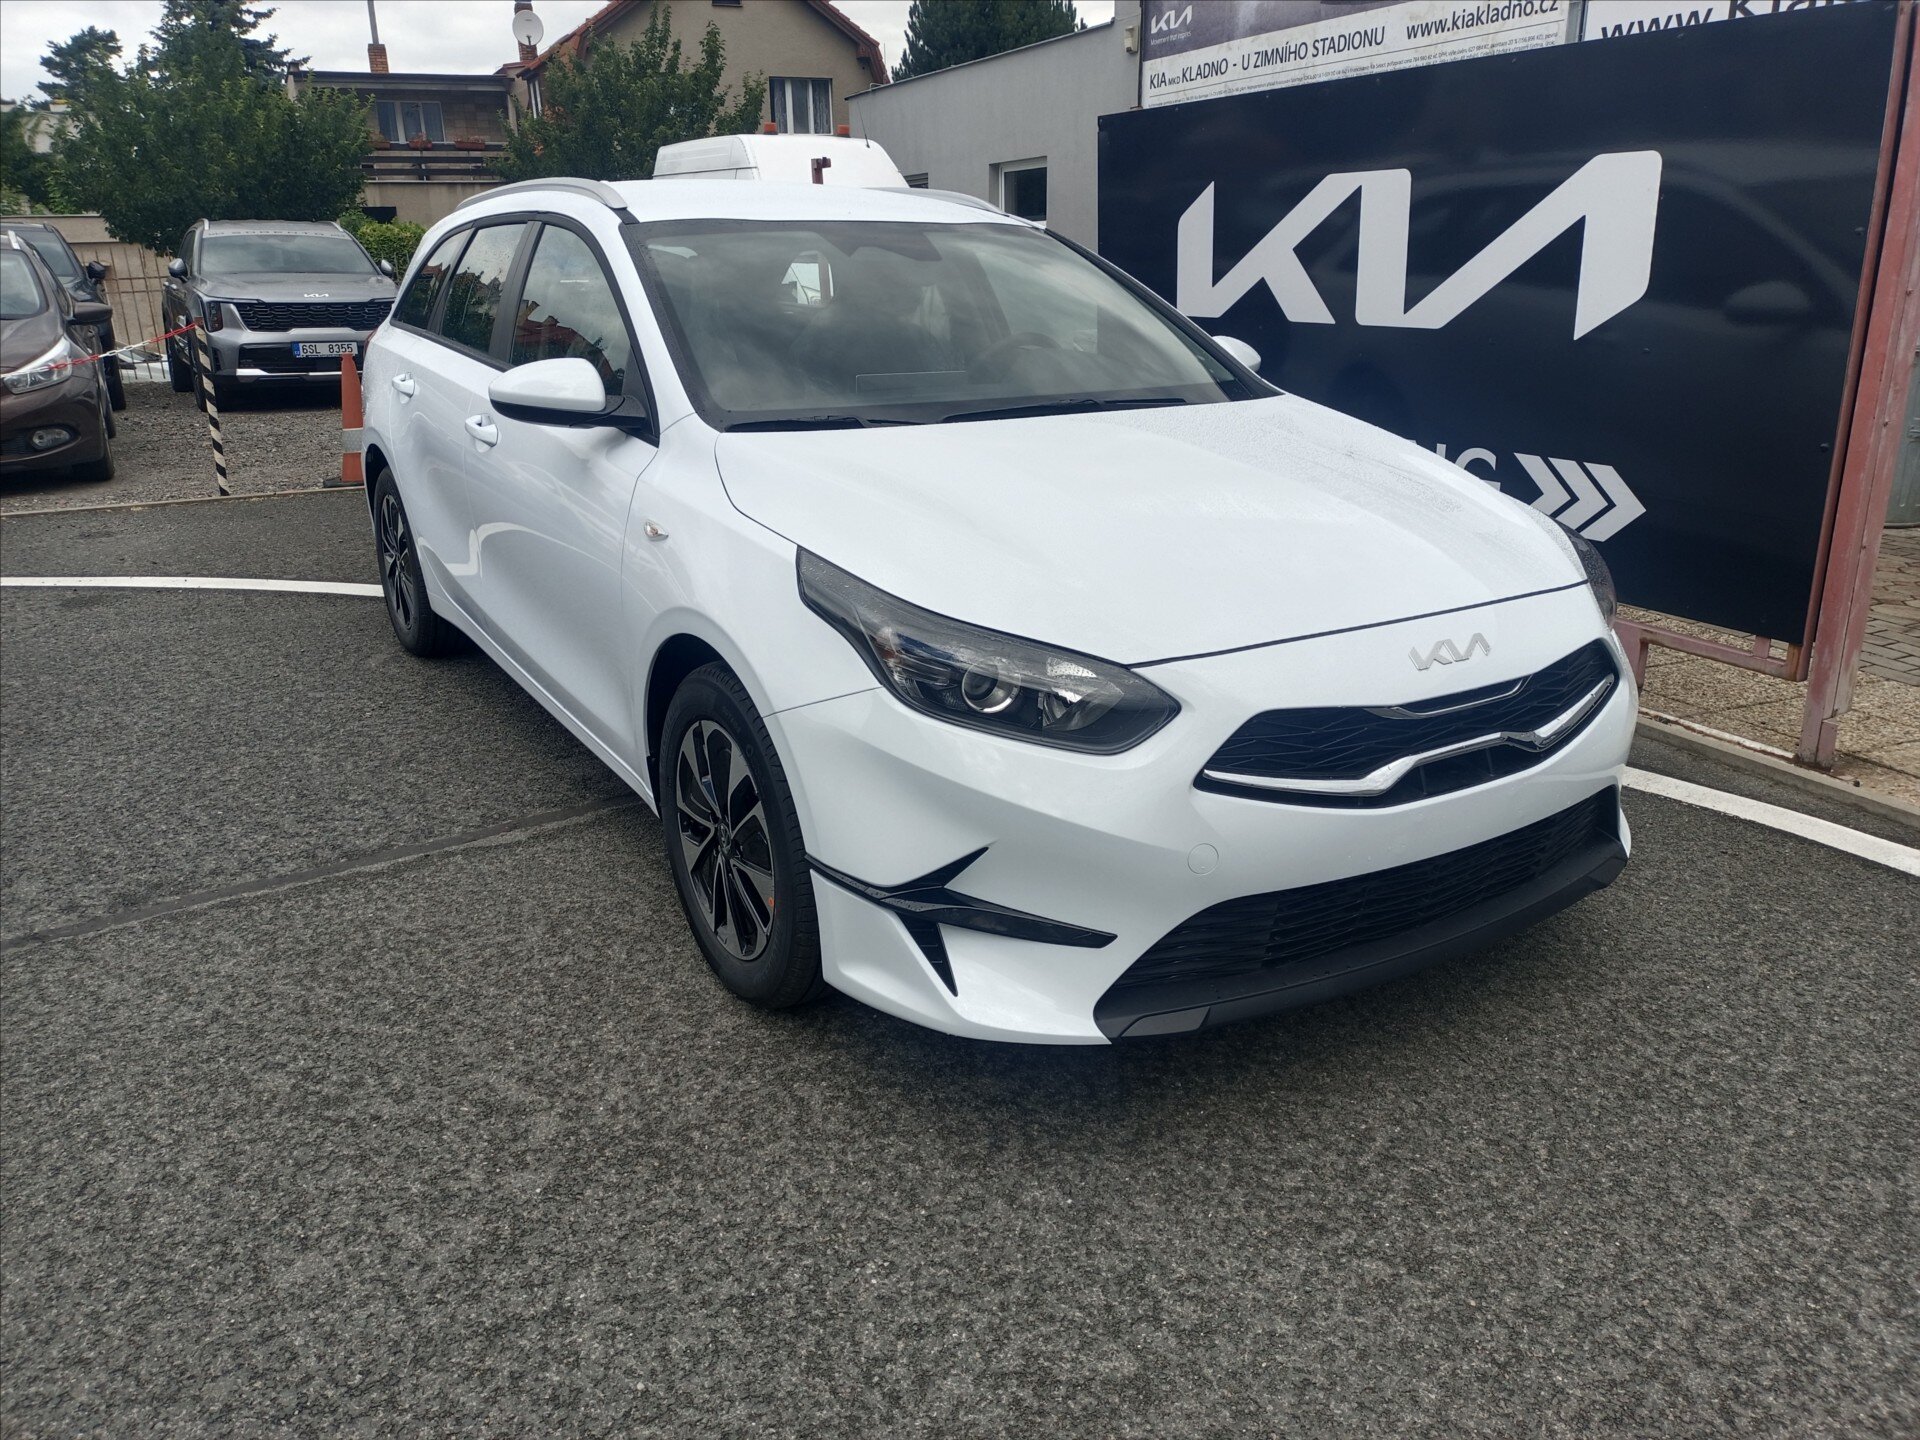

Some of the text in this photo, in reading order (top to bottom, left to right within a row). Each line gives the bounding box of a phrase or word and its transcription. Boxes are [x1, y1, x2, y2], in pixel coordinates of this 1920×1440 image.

[1151, 5, 1193, 34] KIA
[1149, 72, 1167, 89] KIA
[1168, 76, 1181, 86] MKD
[1182, 58, 1229, 83] KLADNO
[1241, 54, 1250, 71] U
[1253, 41, 1309, 69] ZIMNÍHO
[1312, 26, 1386, 58] STADIONU
[1406, 0, 1559, 40] www.kiakladno.cz
[1177, 150, 1662, 340] KIA
[302, 344, 353, 354] 6SL 8355
[1408, 632, 1491, 671] KIA
